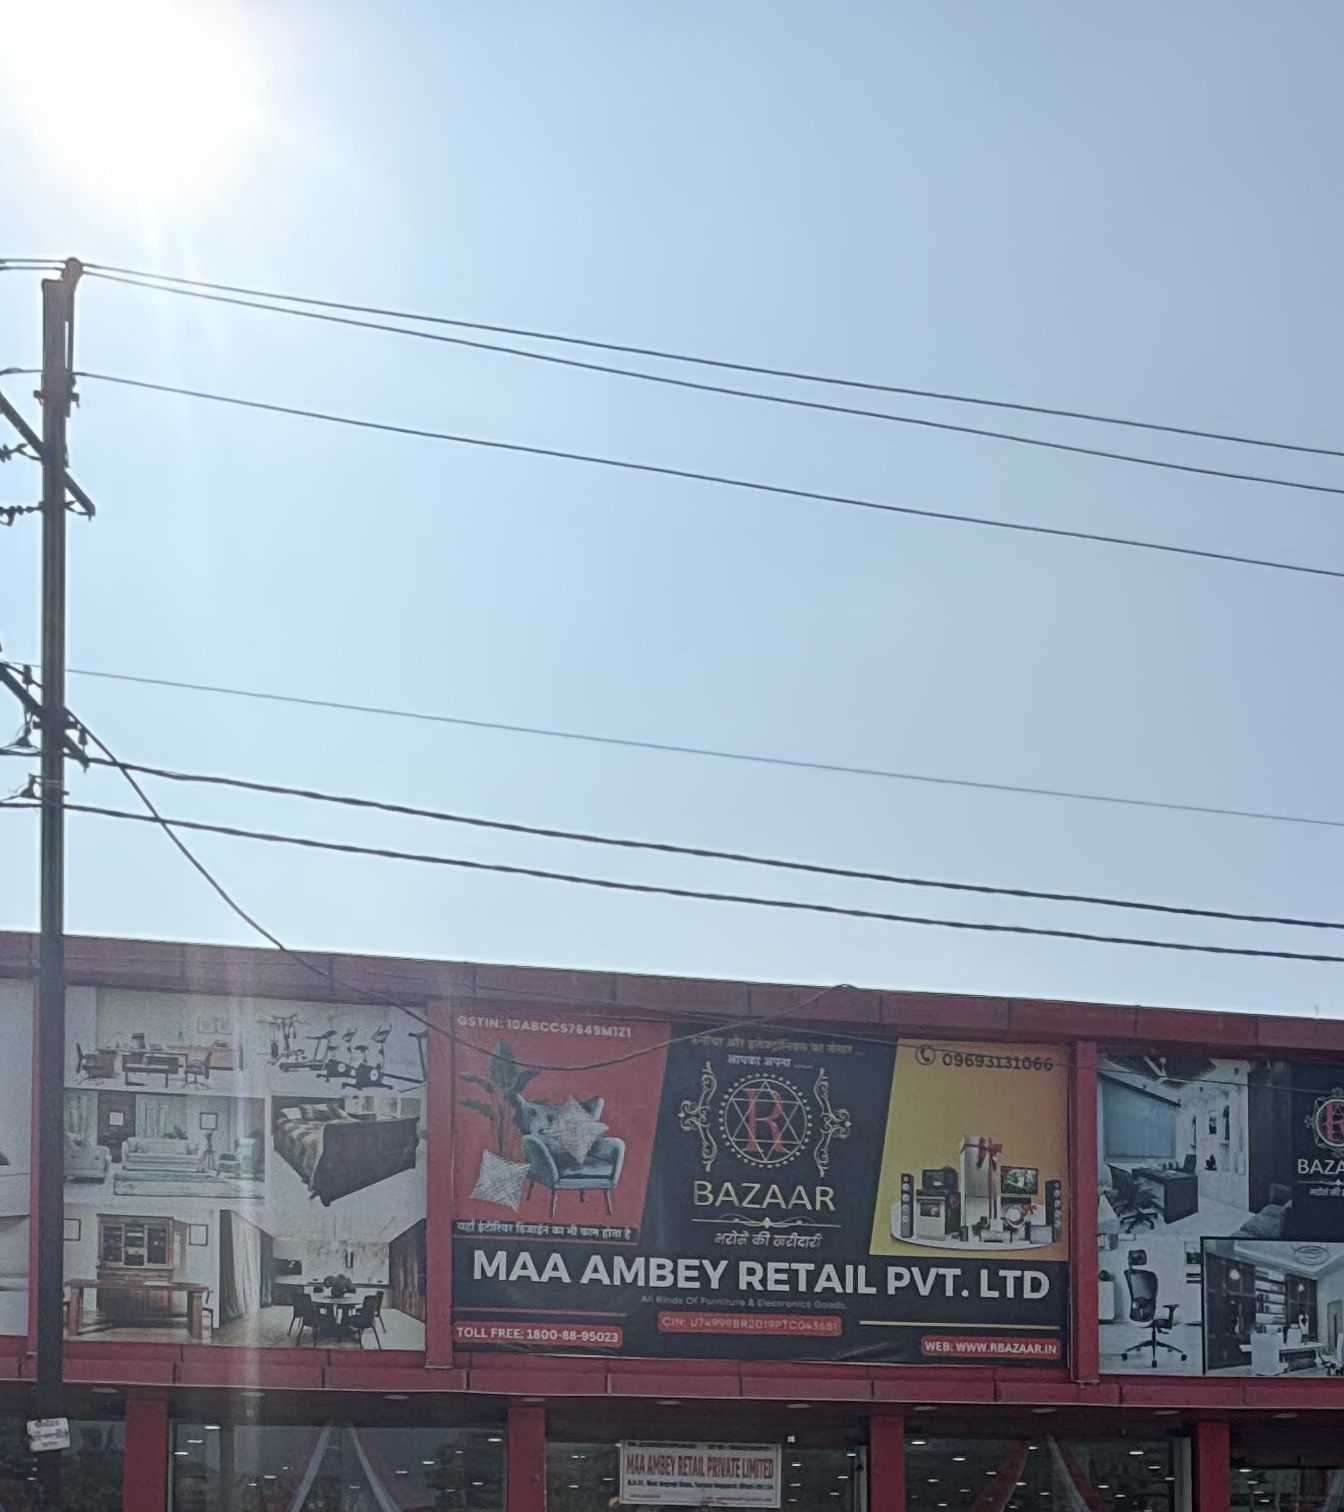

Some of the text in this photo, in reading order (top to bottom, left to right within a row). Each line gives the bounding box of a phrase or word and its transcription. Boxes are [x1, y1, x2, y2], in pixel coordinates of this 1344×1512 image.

[457, 1015, 503, 1029] GSTIN:
[728, 1054, 760, 1067] आपका
[942, 1053, 1054, 1071] 09693131066
[694, 1181, 836, 1211] BAZAAR
[714, 1230, 750, 1246] भरोसे
[752, 1230, 771, 1246] की
[473, 1249, 1050, 1300] MAA AMBEY RETAIL PVT. LTD
[457, 1327, 488, 1339] TOLL
